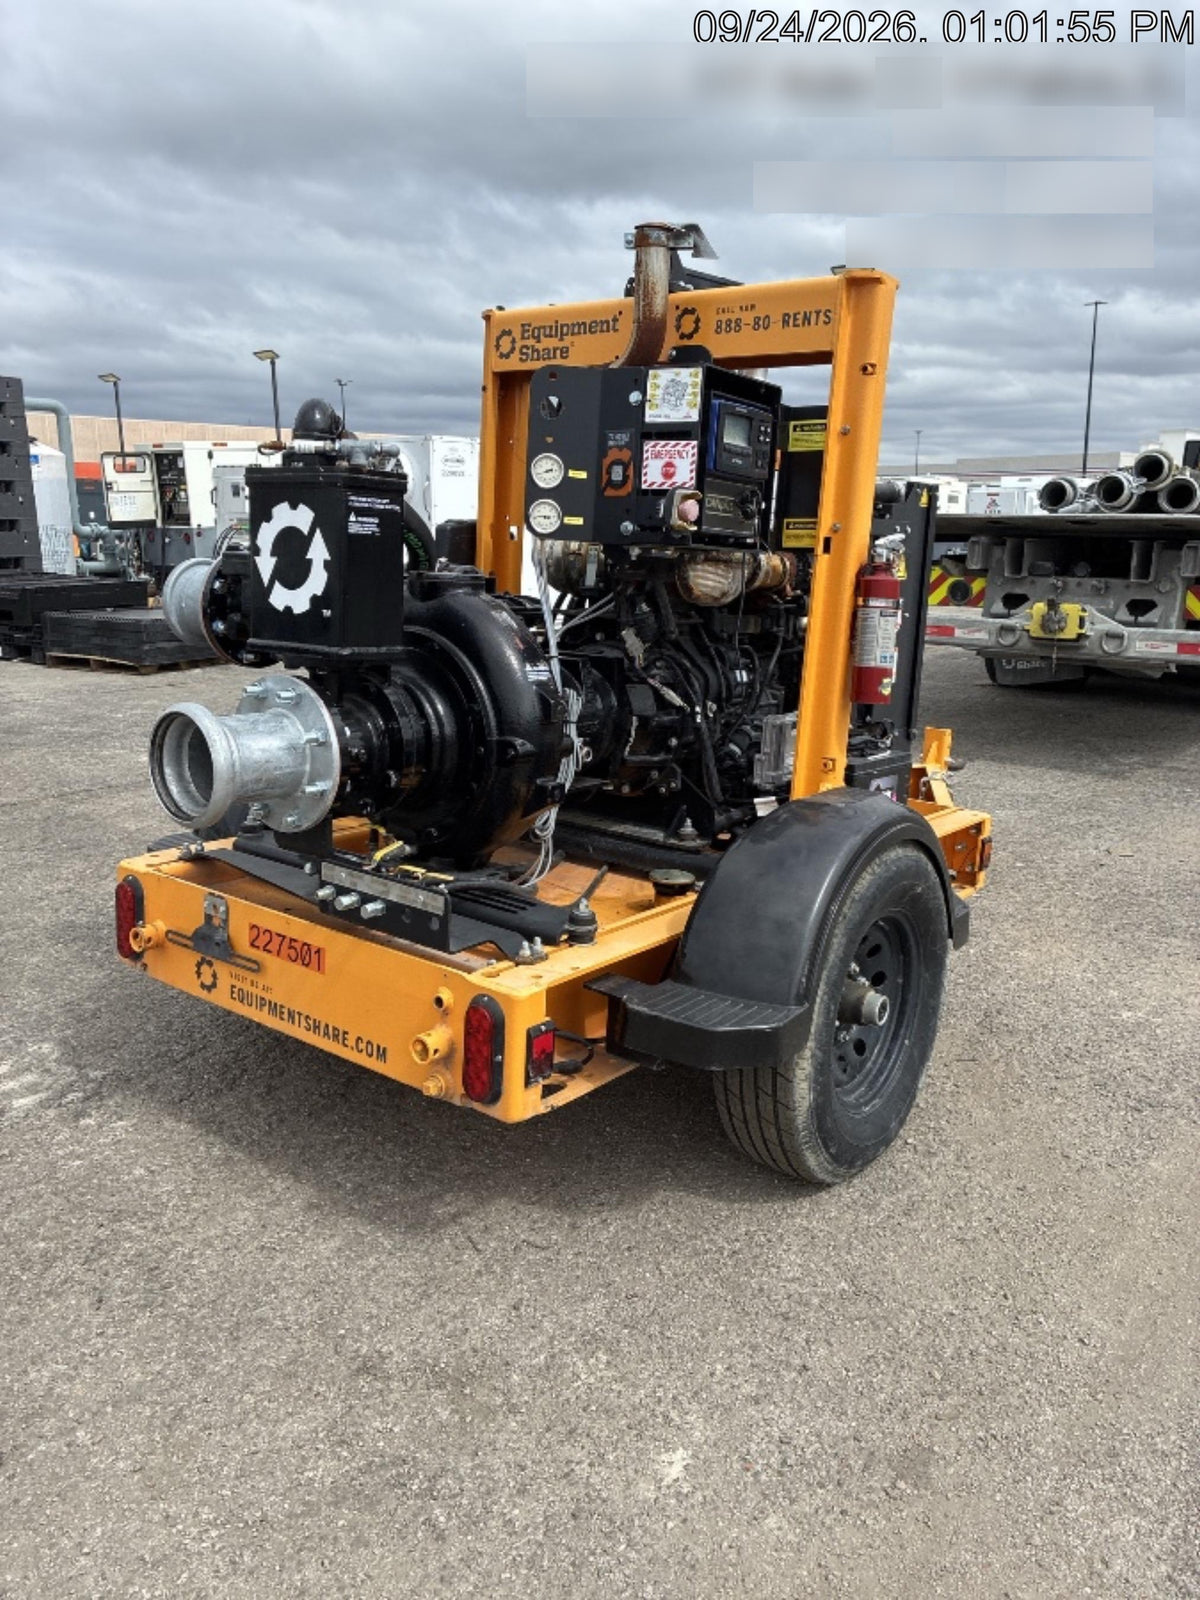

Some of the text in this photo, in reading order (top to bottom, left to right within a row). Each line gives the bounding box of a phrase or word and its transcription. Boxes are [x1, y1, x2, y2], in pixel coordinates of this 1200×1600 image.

[520, 314, 620, 343] Equipment
[714, 308, 832, 335] 888-80-RENTS
[518, 343, 570, 362] Share
[250, 924, 321, 972] 227501
[230, 984, 388, 1064] EQUIPMENTSHARE.COM
